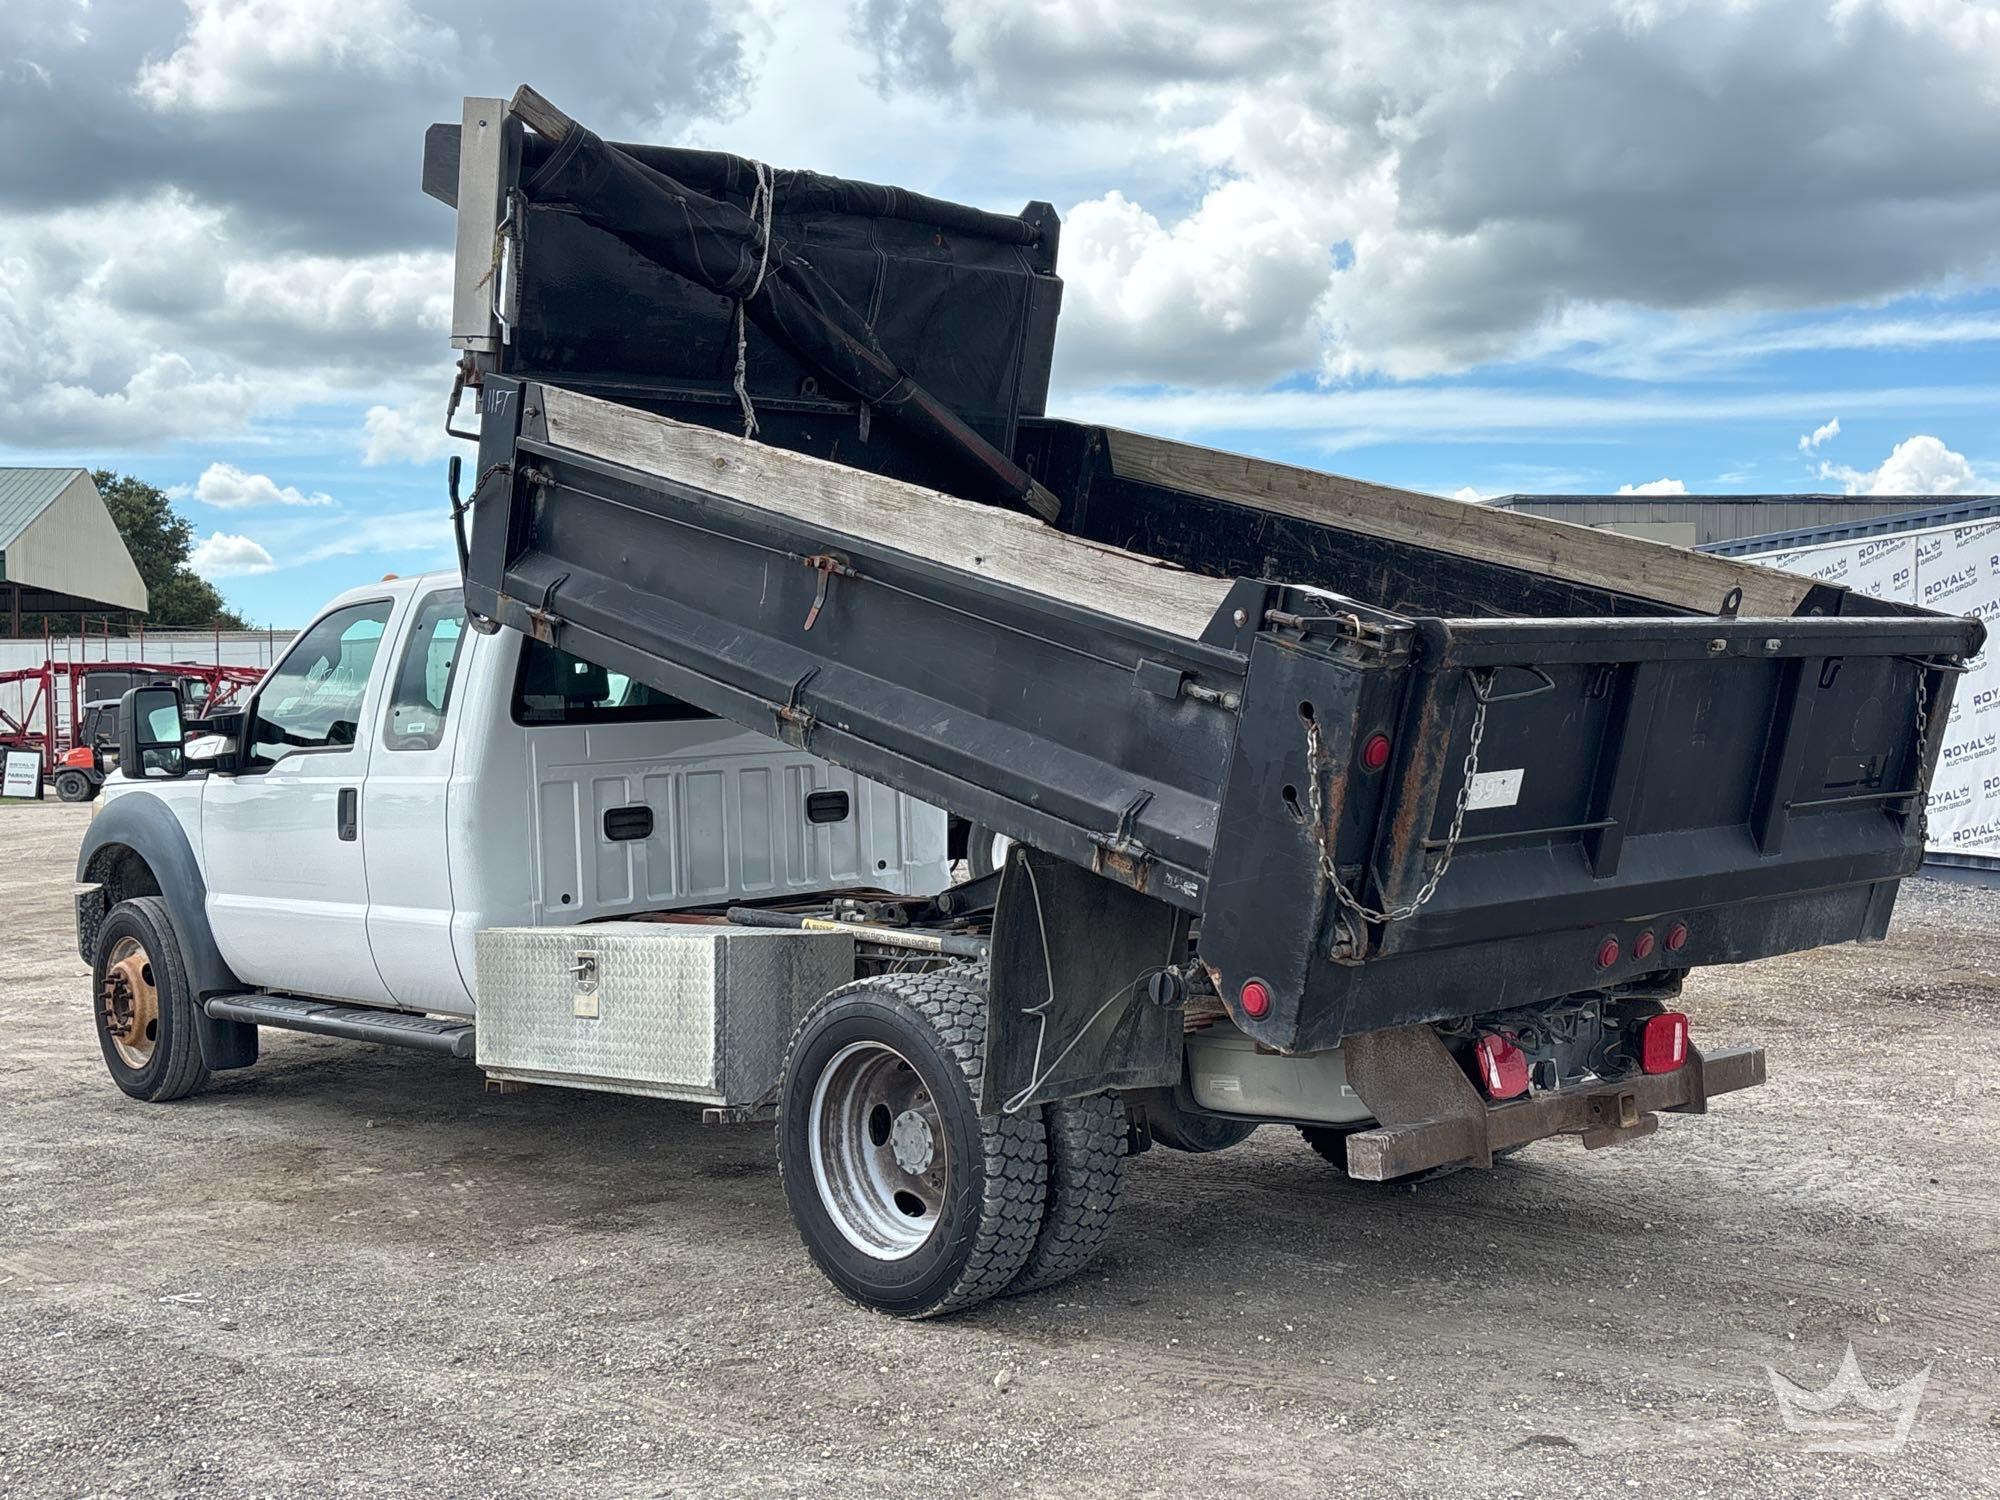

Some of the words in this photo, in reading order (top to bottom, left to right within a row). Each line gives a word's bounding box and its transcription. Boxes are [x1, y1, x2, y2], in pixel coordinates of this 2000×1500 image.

[1956, 530, 1986, 549] AUCTION
[1985, 523, 2000, 535] GRO
[1860, 551, 1886, 568] AUCTION
[1885, 540, 1906, 555] GROUP
[1920, 550, 1943, 566] GROUP
[1811, 563, 1838, 579] OYAL
[1893, 579, 1910, 591] AUCT
[1924, 572, 1966, 597] ROYAL
[1926, 588, 1955, 605] AUCTION
[1954, 577, 1978, 593] GROUP
[1963, 598, 2000, 618] OYA
[1973, 687, 2000, 707] ROY
[1943, 738, 1985, 760] ROYAL
[1945, 753, 1974, 768] AUCTION
[1974, 746, 1998, 760] GROUP
[1926, 803, 1949, 815] CTION
[1949, 797, 1971, 811] GROUP
[1927, 789, 1960, 806] OYAL
[1953, 822, 1995, 843] ROYAL
